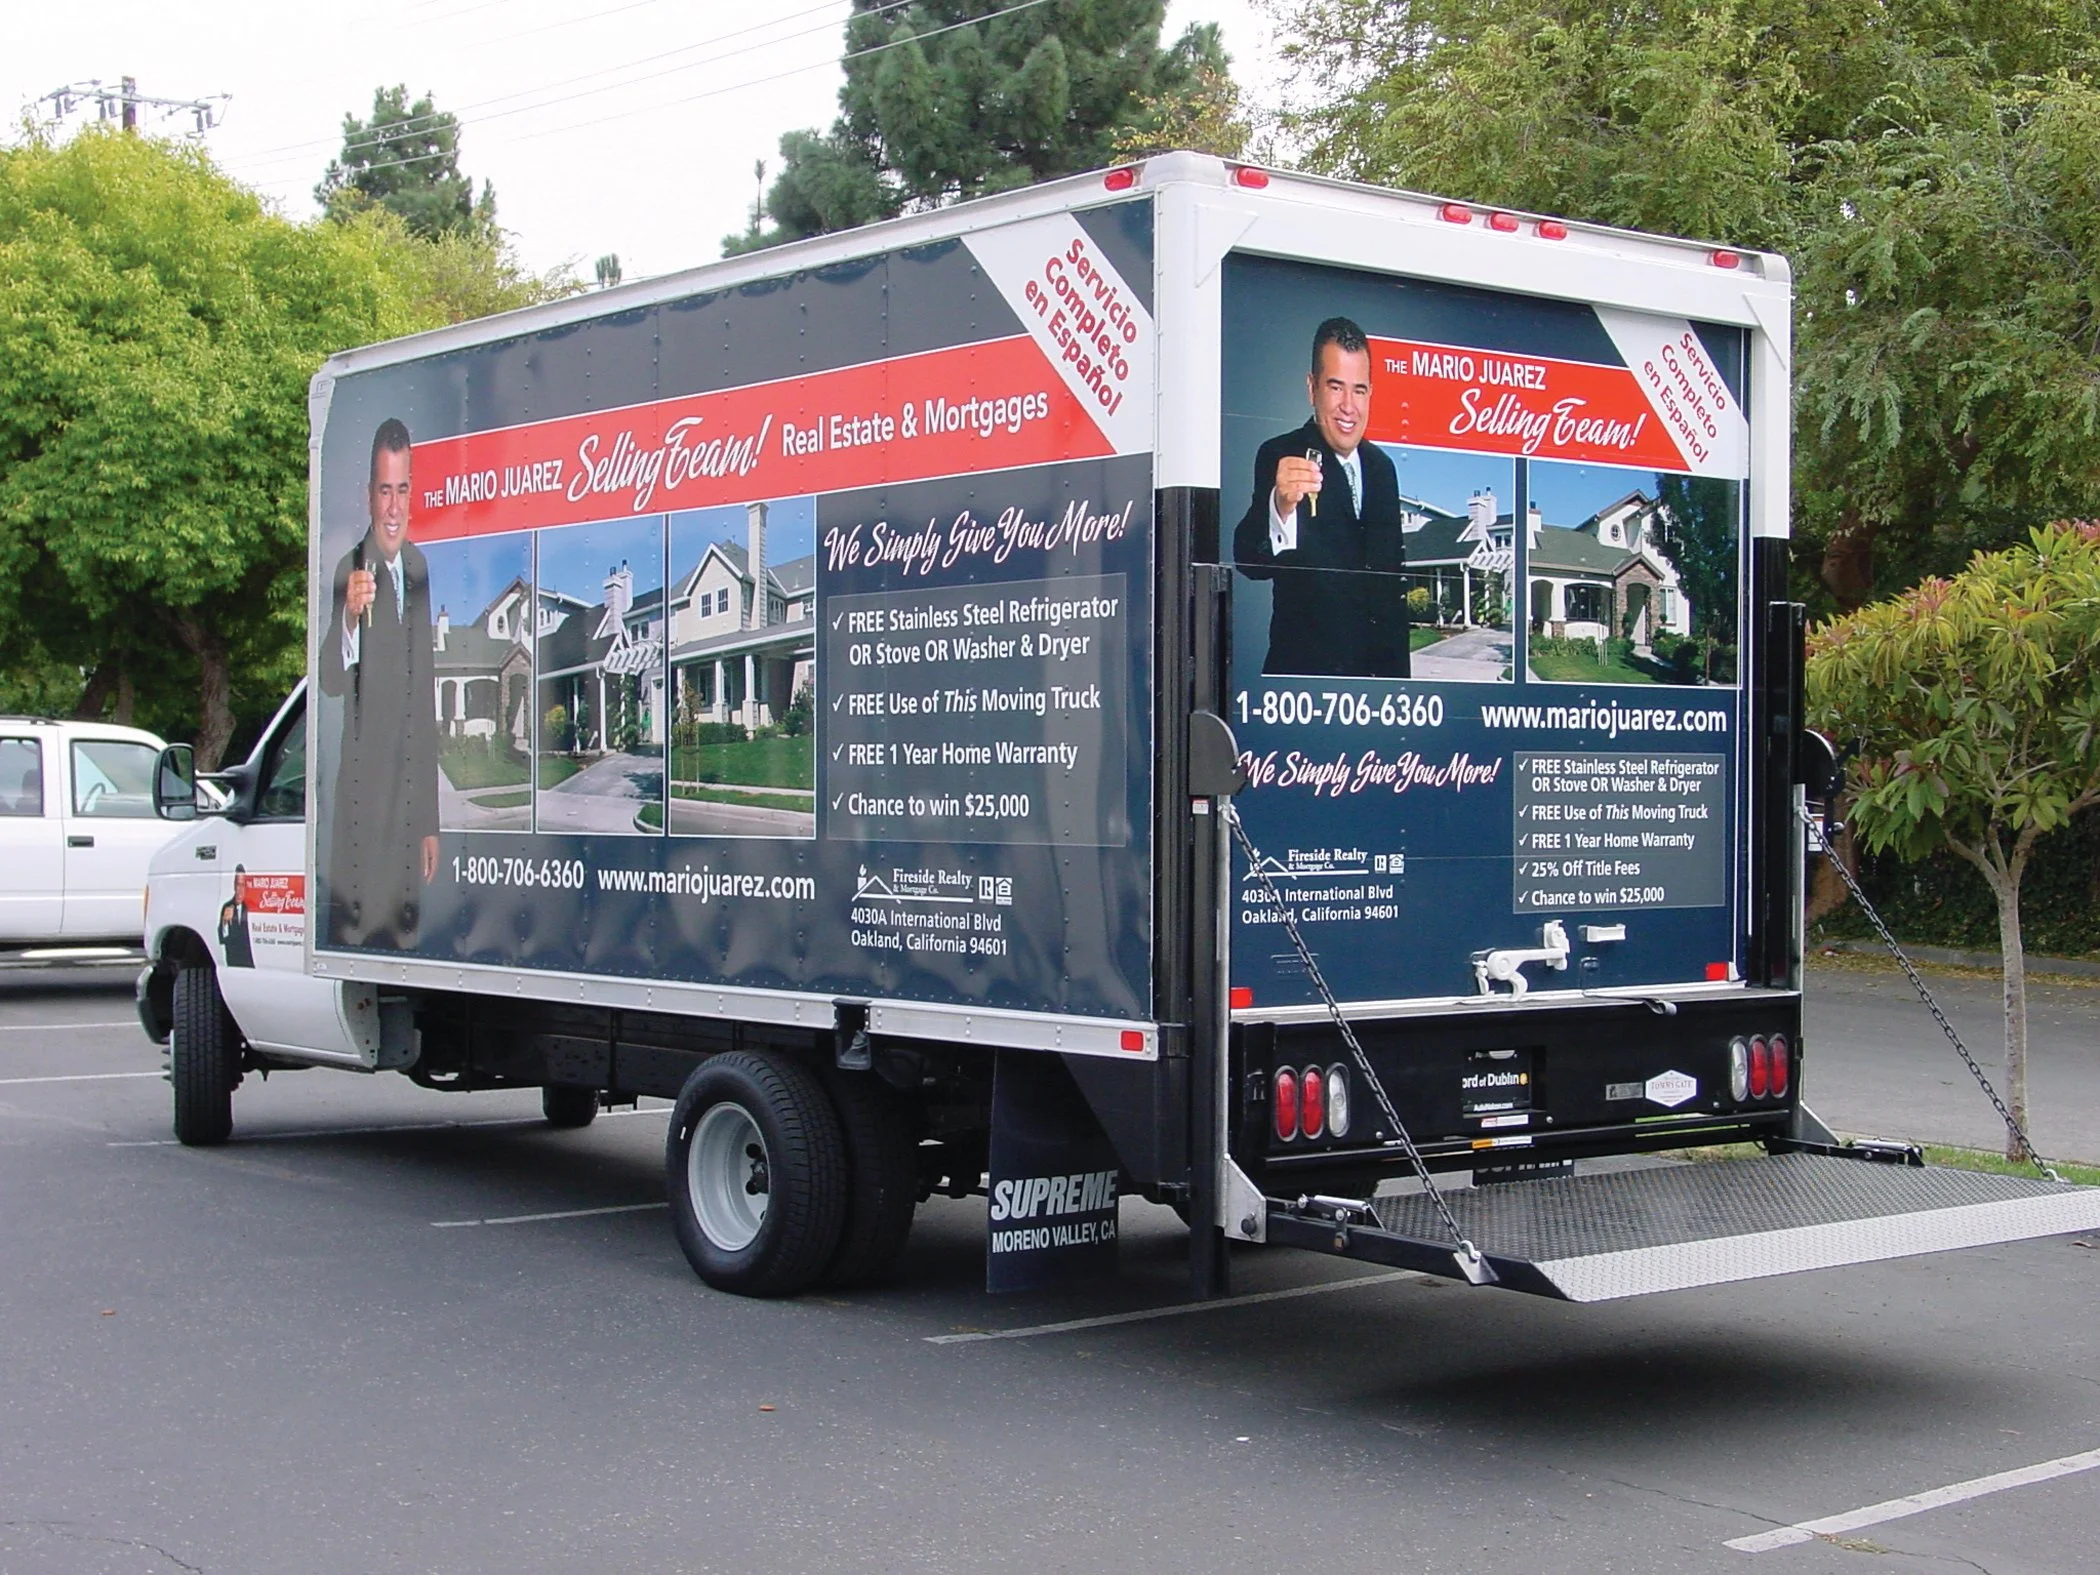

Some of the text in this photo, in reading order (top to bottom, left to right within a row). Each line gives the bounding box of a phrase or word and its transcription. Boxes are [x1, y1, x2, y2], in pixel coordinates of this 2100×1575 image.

[1066, 238, 1137, 344] Servicio
[1044, 257, 1130, 381] Completo
[1024, 280, 1123, 417] en Español
[1385, 351, 1546, 390] THE MARIO JUAREZ
[1679, 332, 1726, 411] Servicio
[1661, 344, 1717, 439] Completo
[1450, 388, 1647, 455] Selling Team!
[1643, 360, 1709, 463] en Español
[424, 391, 1048, 512] THE MARIO JUAREZ Selling Team! Real Estate & Mortgages
[824, 499, 1133, 576] We Simply Give You More!
[848, 595, 1118, 634] FREE Stainless Steel Refrigerator
[849, 633, 1090, 666] OR Stove OR Washer & Dryer
[849, 684, 1101, 716] FREE Use of This Moving Truck
[1236, 690, 1727, 739] 1-800-706-6360 www.mariojuarez.com
[849, 742, 1078, 769] FREE 1 Year Home Warranty
[1532, 759, 1719, 779] FREE Stainless Steel Refrigerator
[1237, 750, 1502, 798] We Simply Give You More!
[1532, 777, 1701, 795] OR Stove OR Washer & Dryer
[848, 793, 1030, 820] Chance to win $25,000
[1532, 804, 1708, 823] FREE Use of This Moving Truck
[1288, 848, 1368, 863] Fireside Realty
[1532, 832, 1695, 850] FREE 1 Year Home Warranty
[452, 856, 815, 904] 1-800-706-6360 www.mariojuarez.com
[893, 868, 973, 889] Fireside Realty
[1531, 860, 1640, 877] 25% Off Title Fees
[1285, 886, 1364, 901] International
[1368, 884, 1393, 899] Blvd
[1531, 886, 1665, 907] Chance to win $25,000
[851, 907, 1001, 932] 4030A International Blvd
[1302, 905, 1361, 921] California
[1364, 905, 1399, 919] 94601
[851, 931, 1007, 955] Oakland, California 94601
[1487, 1072, 1519, 1086] Dublin
[990, 1170, 1118, 1221] SUPREME
[992, 1219, 1116, 1253] MORENO VALLEY, CA
